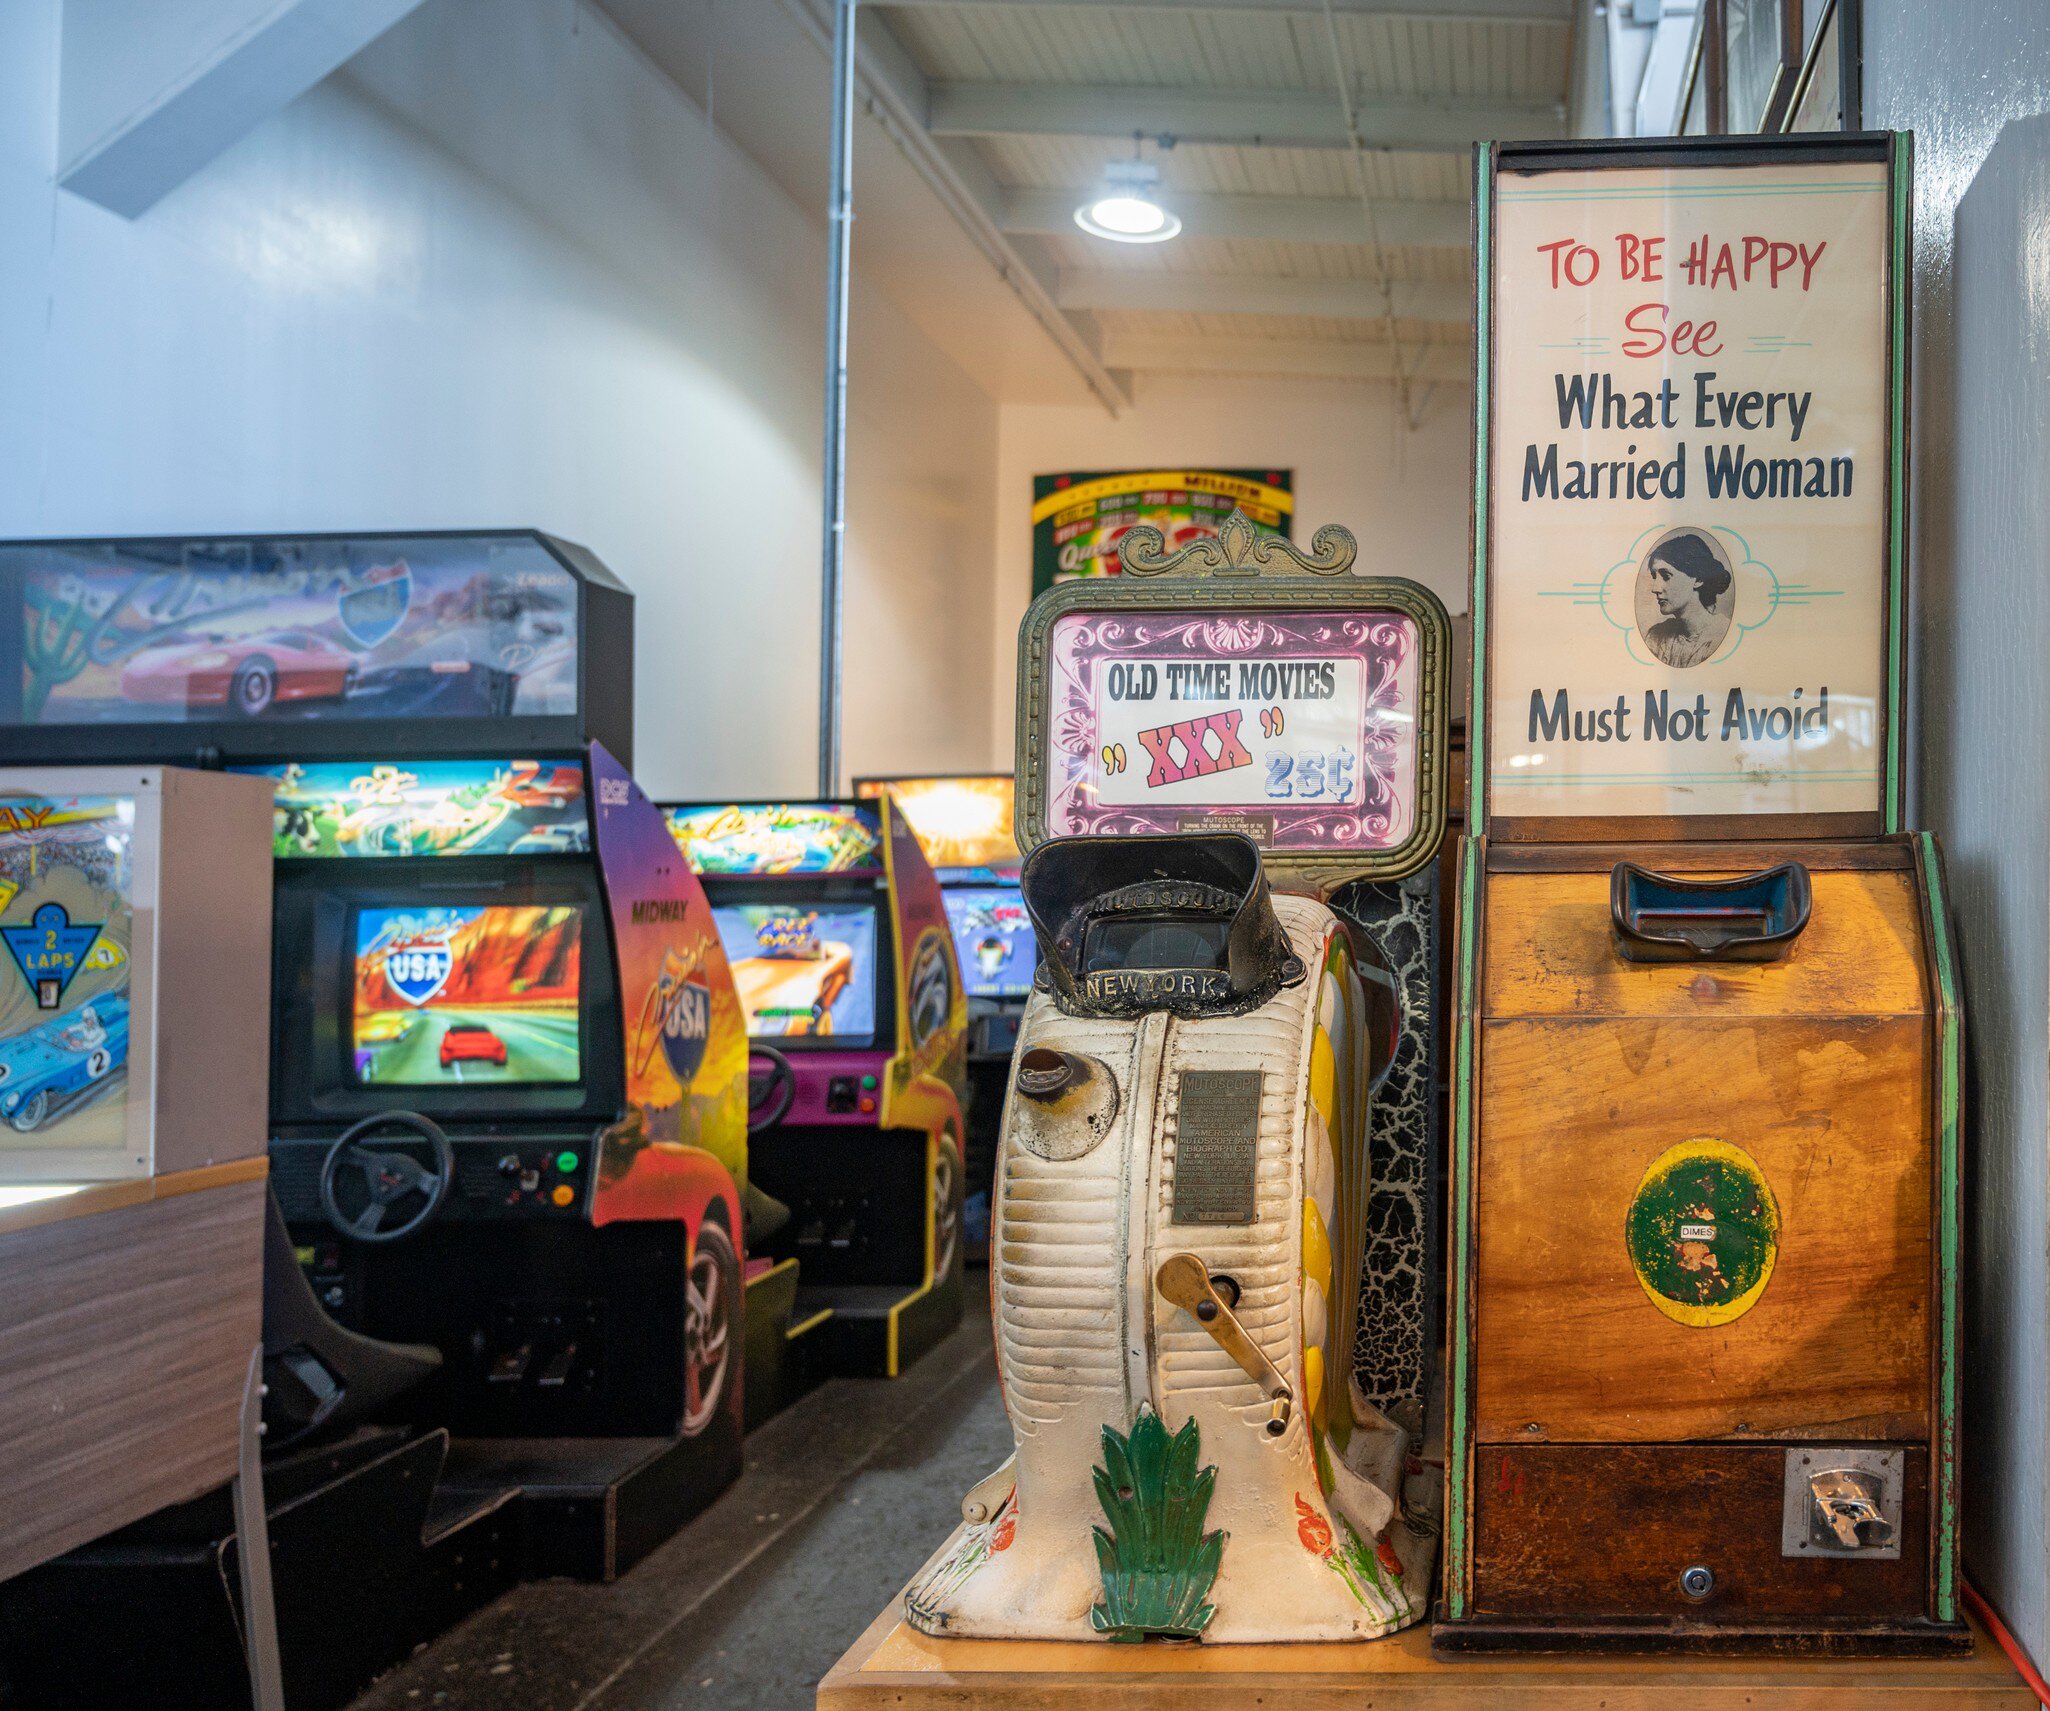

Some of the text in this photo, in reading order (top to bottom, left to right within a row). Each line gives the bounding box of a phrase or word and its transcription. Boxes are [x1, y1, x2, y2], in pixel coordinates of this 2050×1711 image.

[1537, 233, 1827, 292] TO BE HAPPY
[1622, 303, 1724, 359] See
[1555, 372, 1812, 442] What Every
[1521, 442, 1853, 502] Married Woman
[1108, 661, 1336, 701] OLD TIME MOVIES
[1528, 687, 1829, 743] Must Not Avoid
[631, 899, 689, 925] MIDWAY
[45, 929, 57, 950] 2
[26, 952, 75, 969] LAPS
[391, 954, 442, 983] USA
[1085, 975, 1139, 999] NEW
[664, 988, 706, 1040] USA
[1184, 1075, 1260, 1094] MUTOSCOPE
[1179, 1137, 1256, 1145] MUTOSCOPE AND
[1194, 1129, 1241, 1137] AMERICAN
[1682, 1227, 1713, 1236] DIMES
